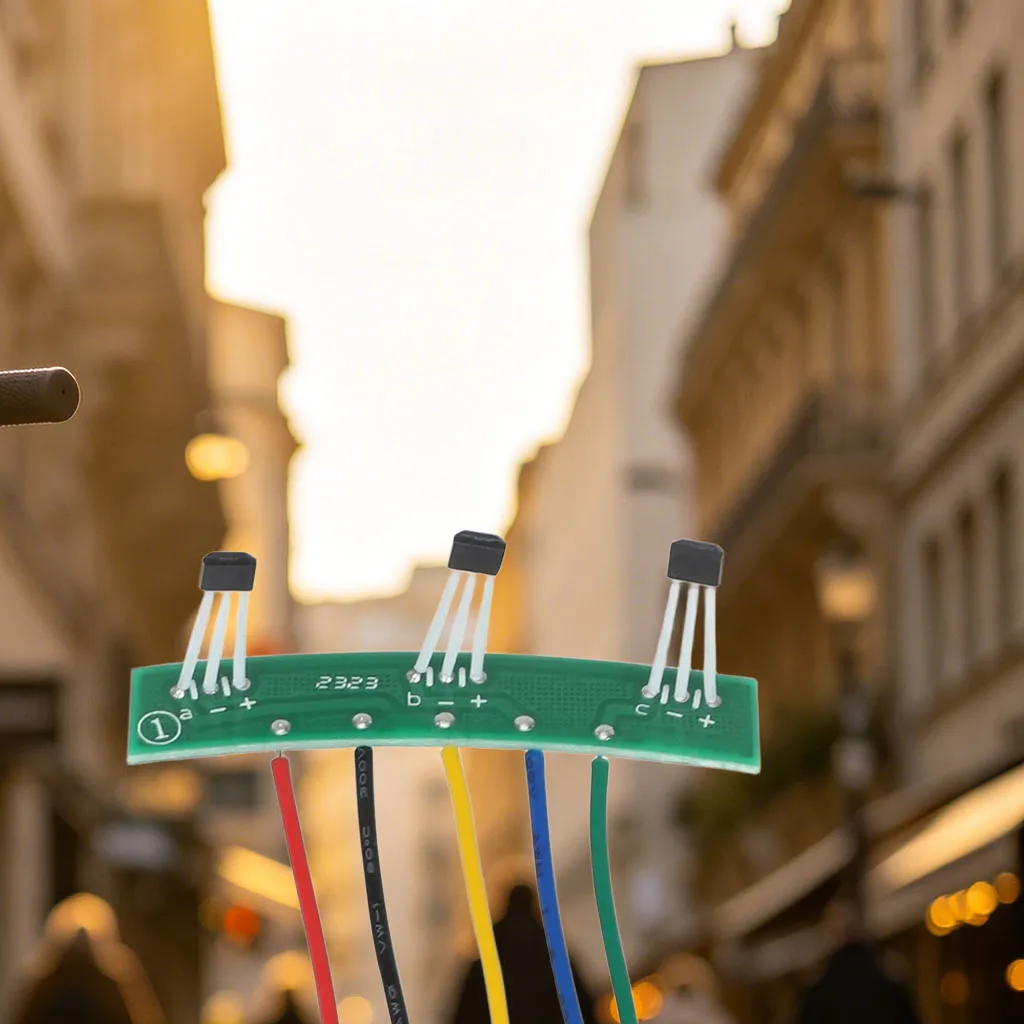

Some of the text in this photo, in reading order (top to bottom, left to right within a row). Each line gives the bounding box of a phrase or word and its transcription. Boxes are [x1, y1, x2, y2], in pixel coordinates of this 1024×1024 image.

[315, 675, 379, 690] 2323
[407, 692, 422, 707] b
[179, 708, 194, 721] a
[635, 703, 651, 716] c
